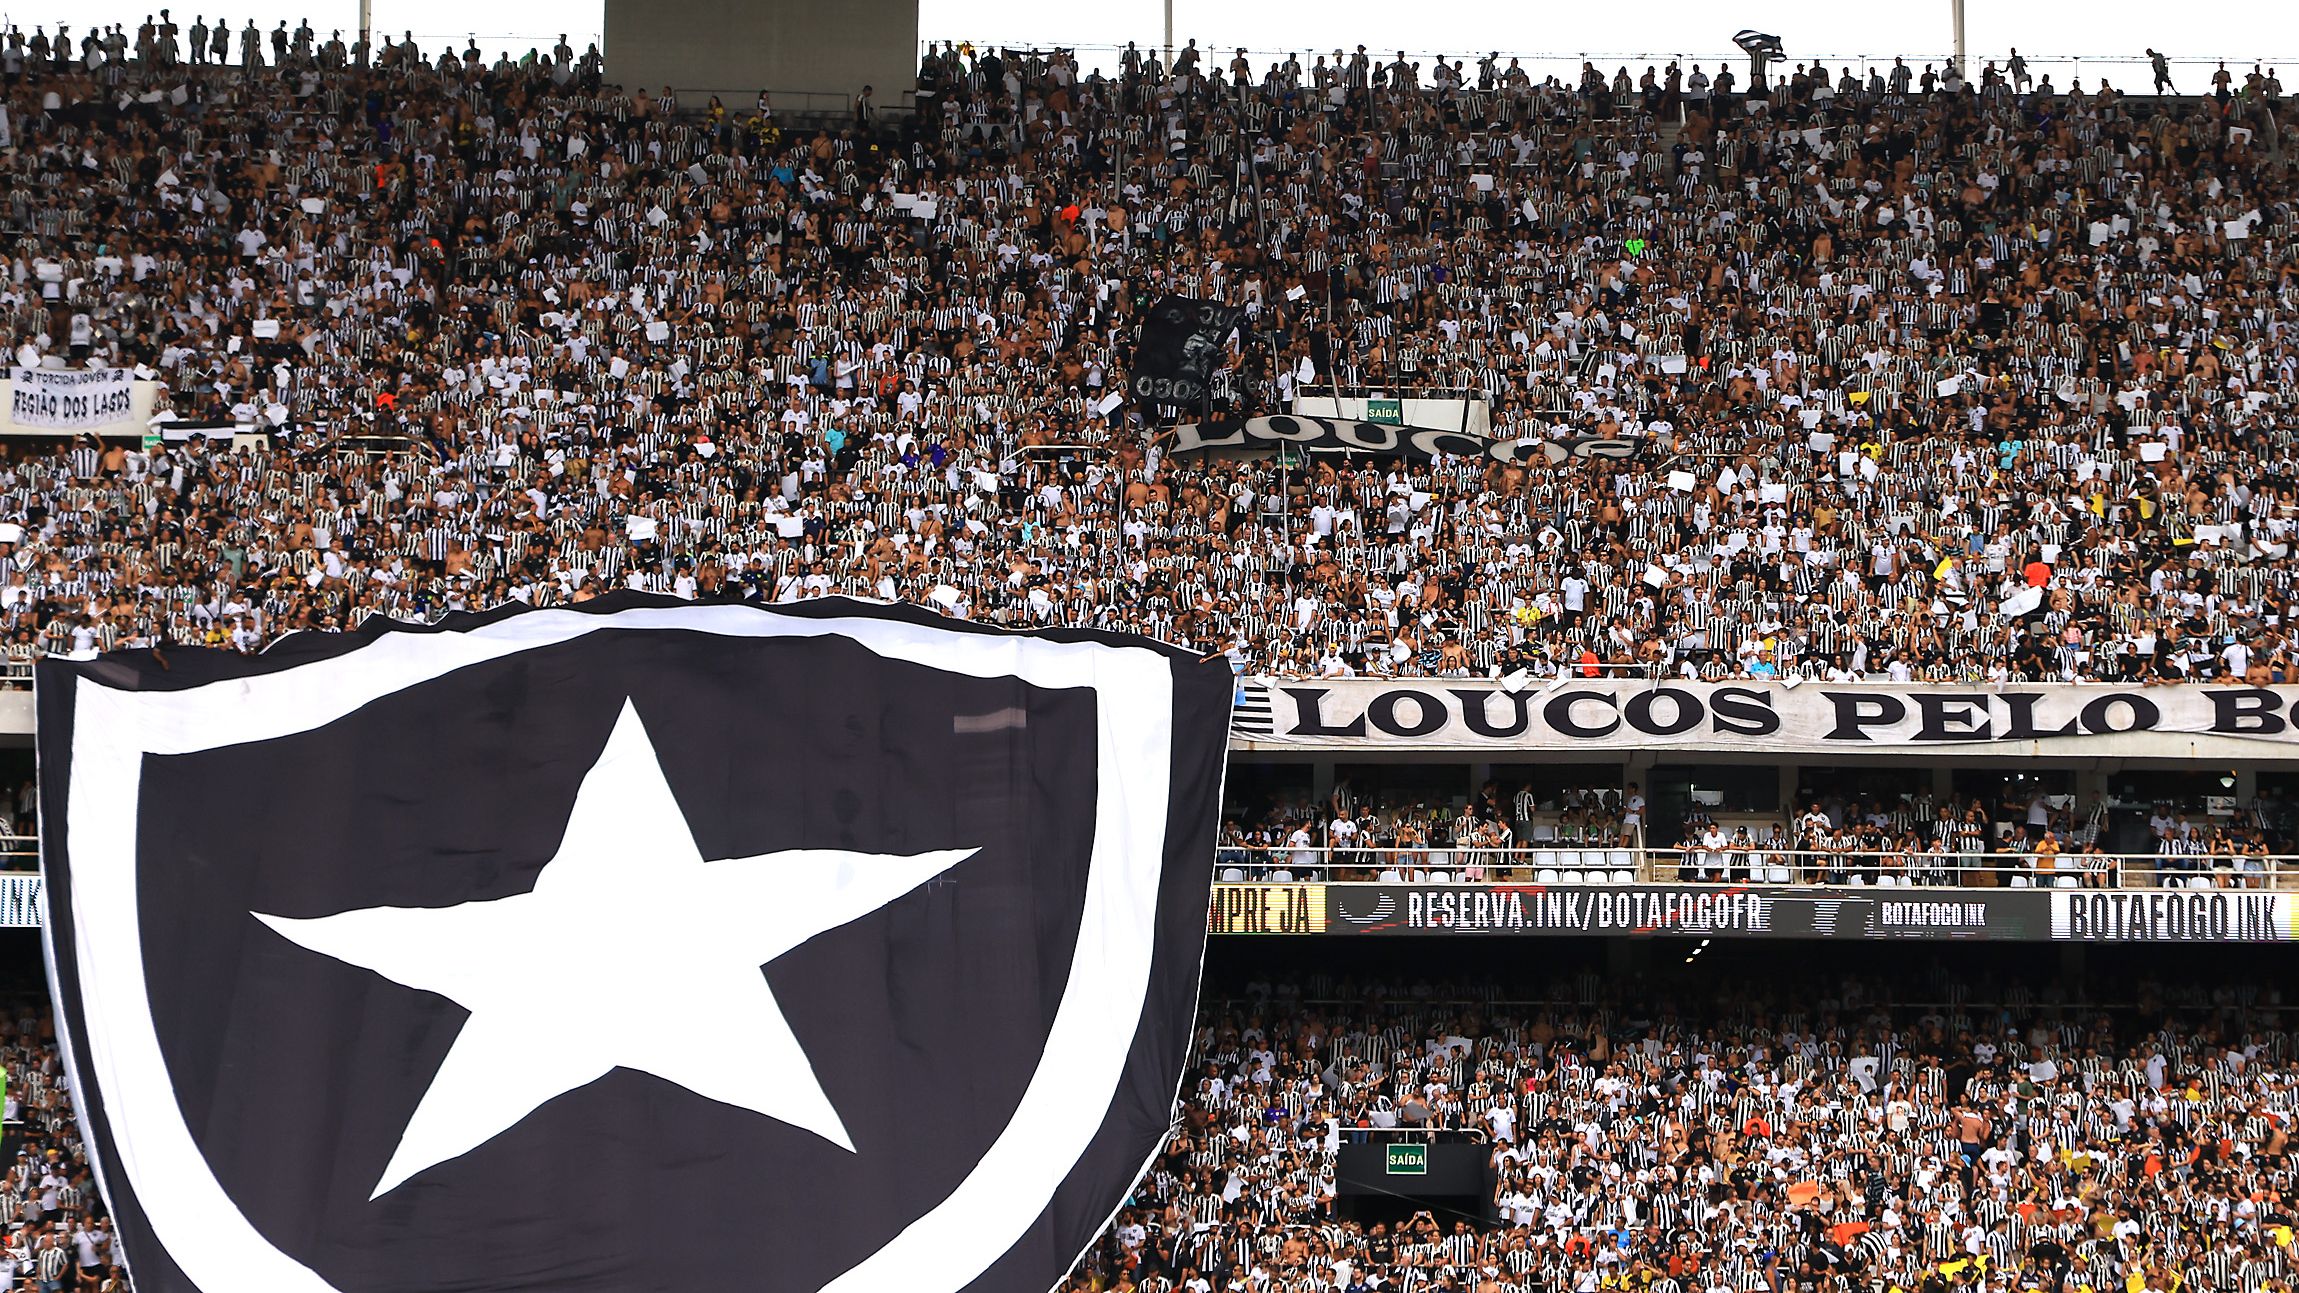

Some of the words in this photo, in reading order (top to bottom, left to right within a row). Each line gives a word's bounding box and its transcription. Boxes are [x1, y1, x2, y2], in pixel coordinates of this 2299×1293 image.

[36, 373, 76, 385] TORCIDA
[78, 371, 108, 384] JOVEM
[13, 388, 57, 417] REGIÃO
[63, 395, 88, 418] DOS
[94, 387, 131, 414] LAGOS
[1368, 406, 1400, 418] SAÍDA
[1280, 686, 1781, 739] LOUCOS
[1820, 691, 2161, 741] PELO
[2200, 688, 2299, 734] B
[1408, 891, 1763, 930] RESERVA.INK/BOTAFOGOFR
[1881, 901, 1962, 926] BOTAFOGO
[1964, 902, 1986, 926] INK
[2070, 893, 2228, 941] BOTAFOGO
[2237, 895, 2278, 941] INK
[1389, 1153, 1424, 1166] SAÍDA
